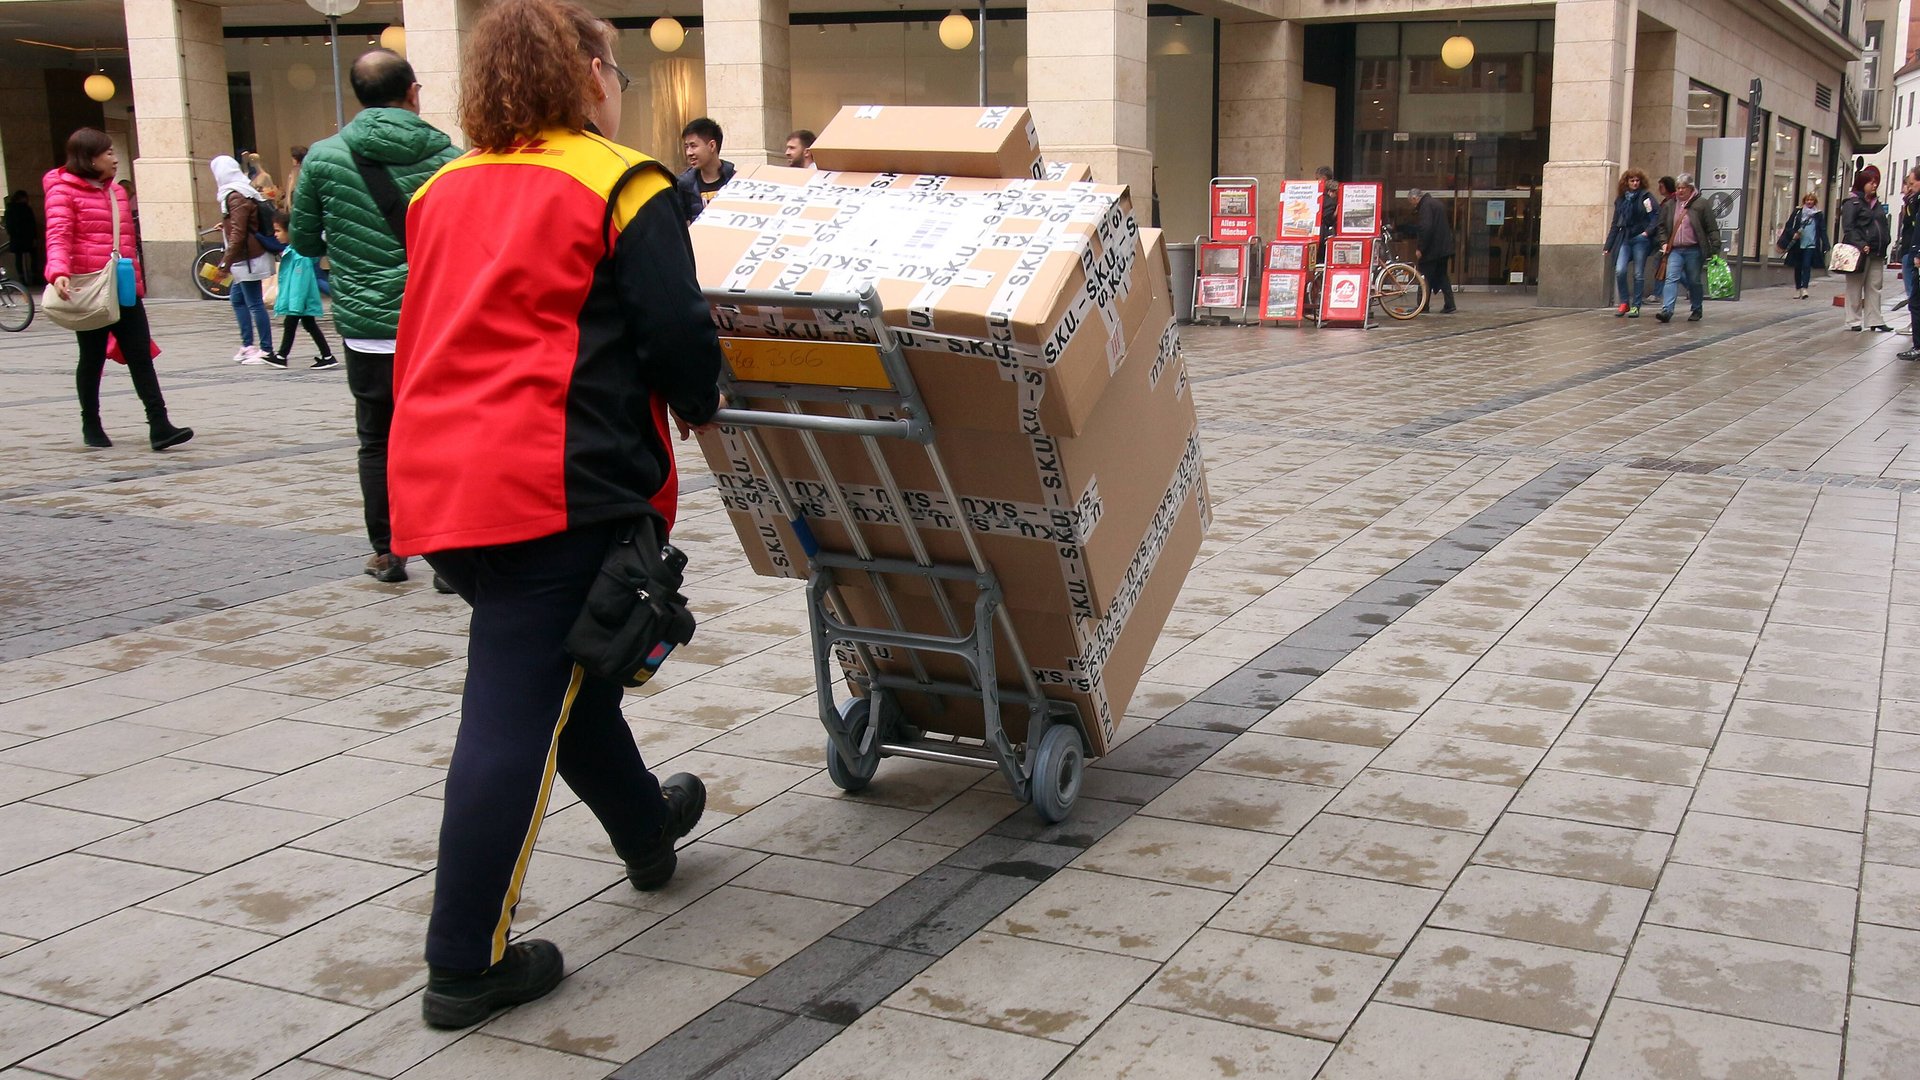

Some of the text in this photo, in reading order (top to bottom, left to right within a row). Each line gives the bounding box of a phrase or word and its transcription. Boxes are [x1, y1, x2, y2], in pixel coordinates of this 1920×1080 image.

[735, 233, 782, 276] S.K.U.
[1220, 227, 1247, 236] München
[1044, 309, 1080, 364] S.K.U.
[1034, 434, 1062, 489] S.K.U.
[759, 523, 790, 568] S.K.U.
[1100, 701, 1114, 749] S.K.U.
